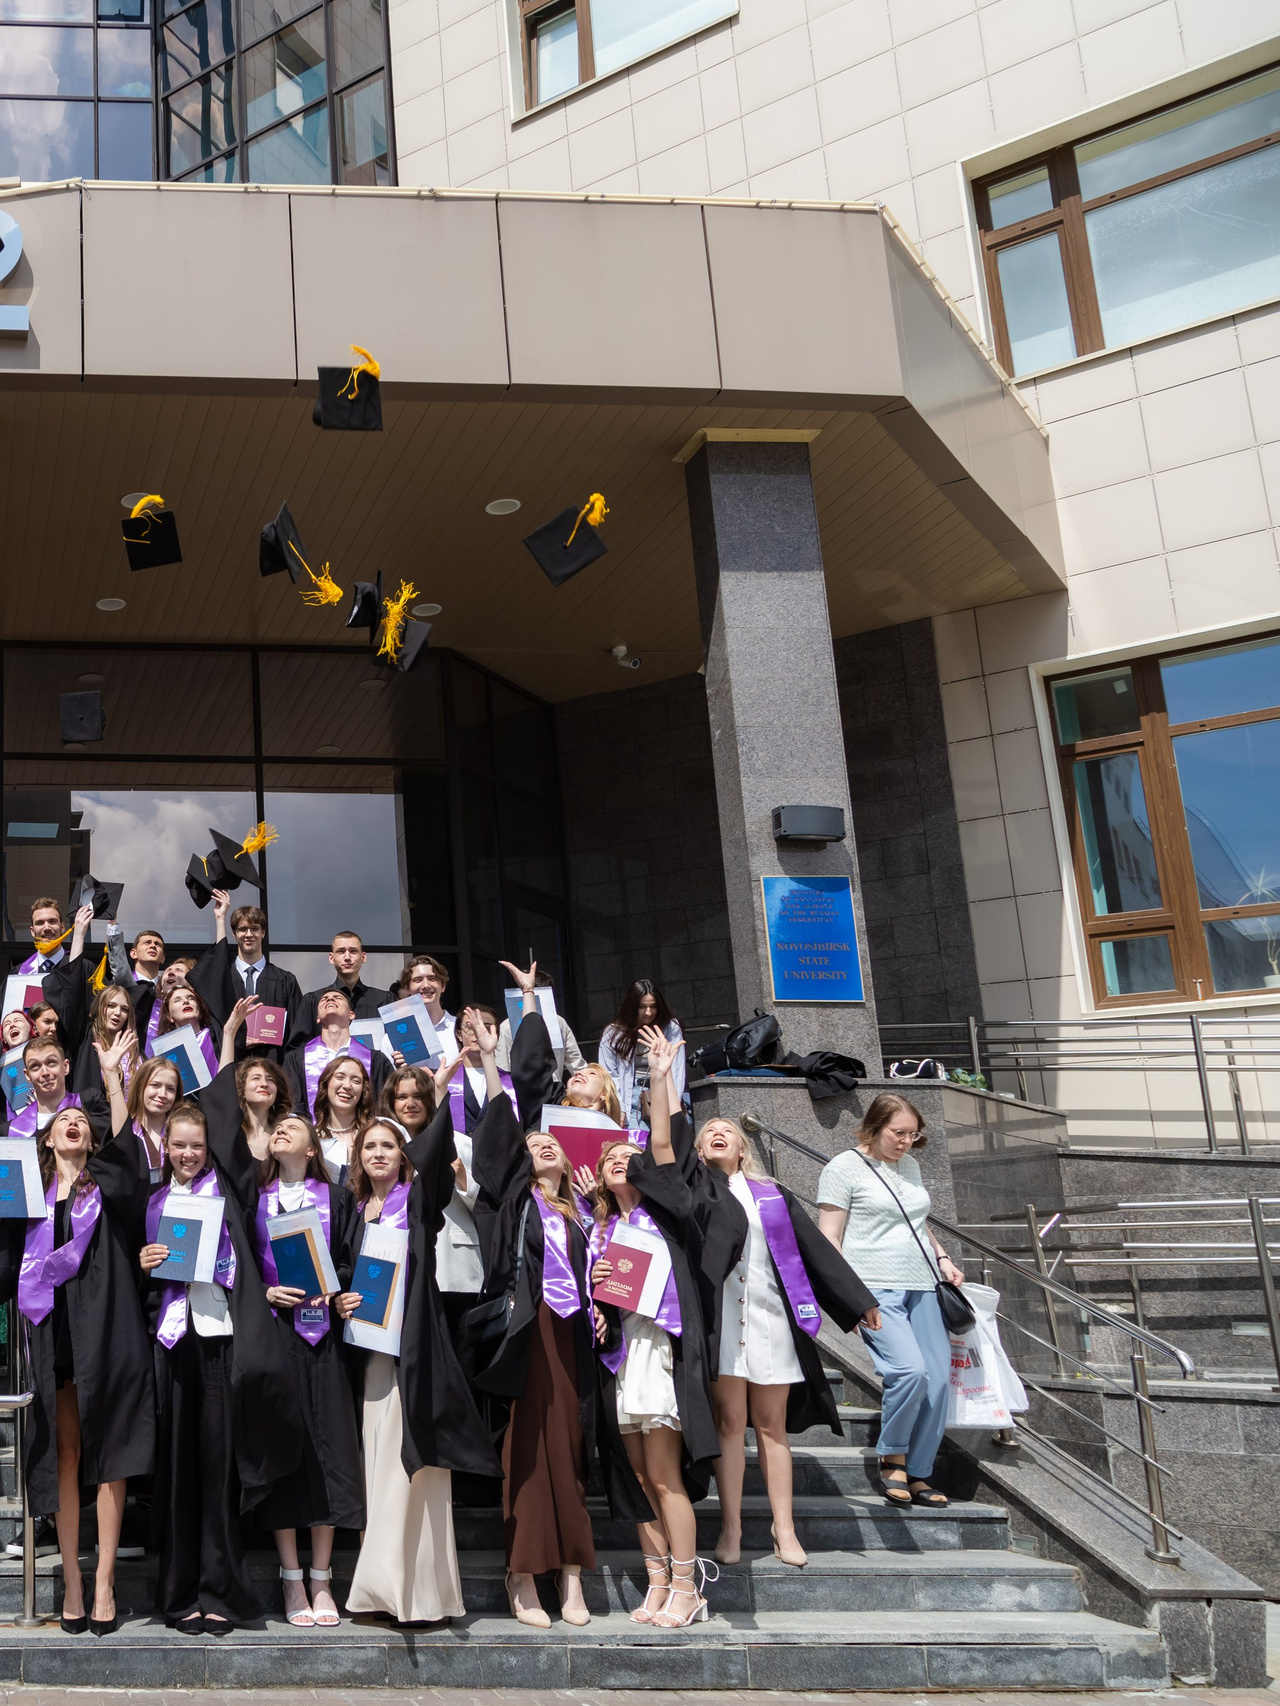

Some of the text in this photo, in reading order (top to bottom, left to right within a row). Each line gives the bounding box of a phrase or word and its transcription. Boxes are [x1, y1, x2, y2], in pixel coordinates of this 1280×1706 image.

[776, 942, 851, 951] NOVOSIBIRSK
[798, 956, 832, 965] STATE
[784, 970, 848, 980] UNIVERSITY
[605, 1279, 633, 1292] ДИПЛОМ
